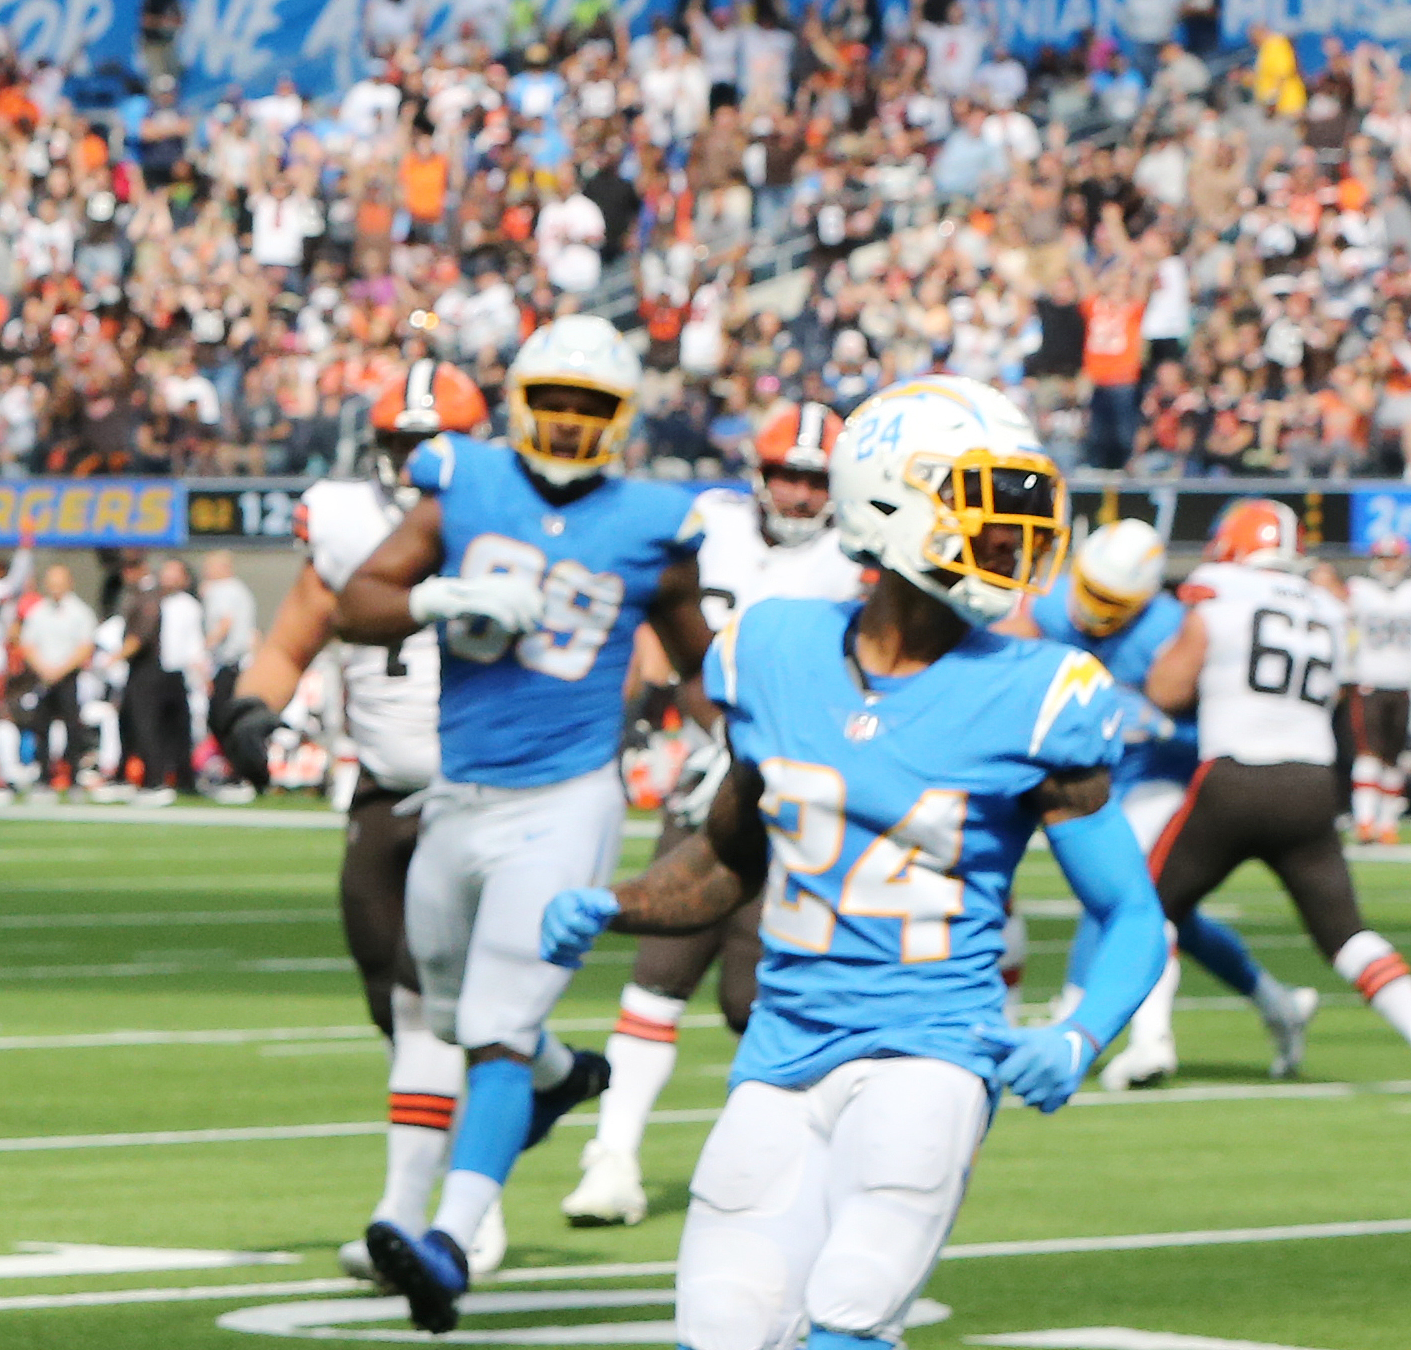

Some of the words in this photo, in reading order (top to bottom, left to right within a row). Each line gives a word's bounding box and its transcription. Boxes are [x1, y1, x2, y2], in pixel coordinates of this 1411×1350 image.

[855, 411, 906, 462] 24
[1248, 607, 1335, 708] 62
[758, 756, 968, 963] 24
